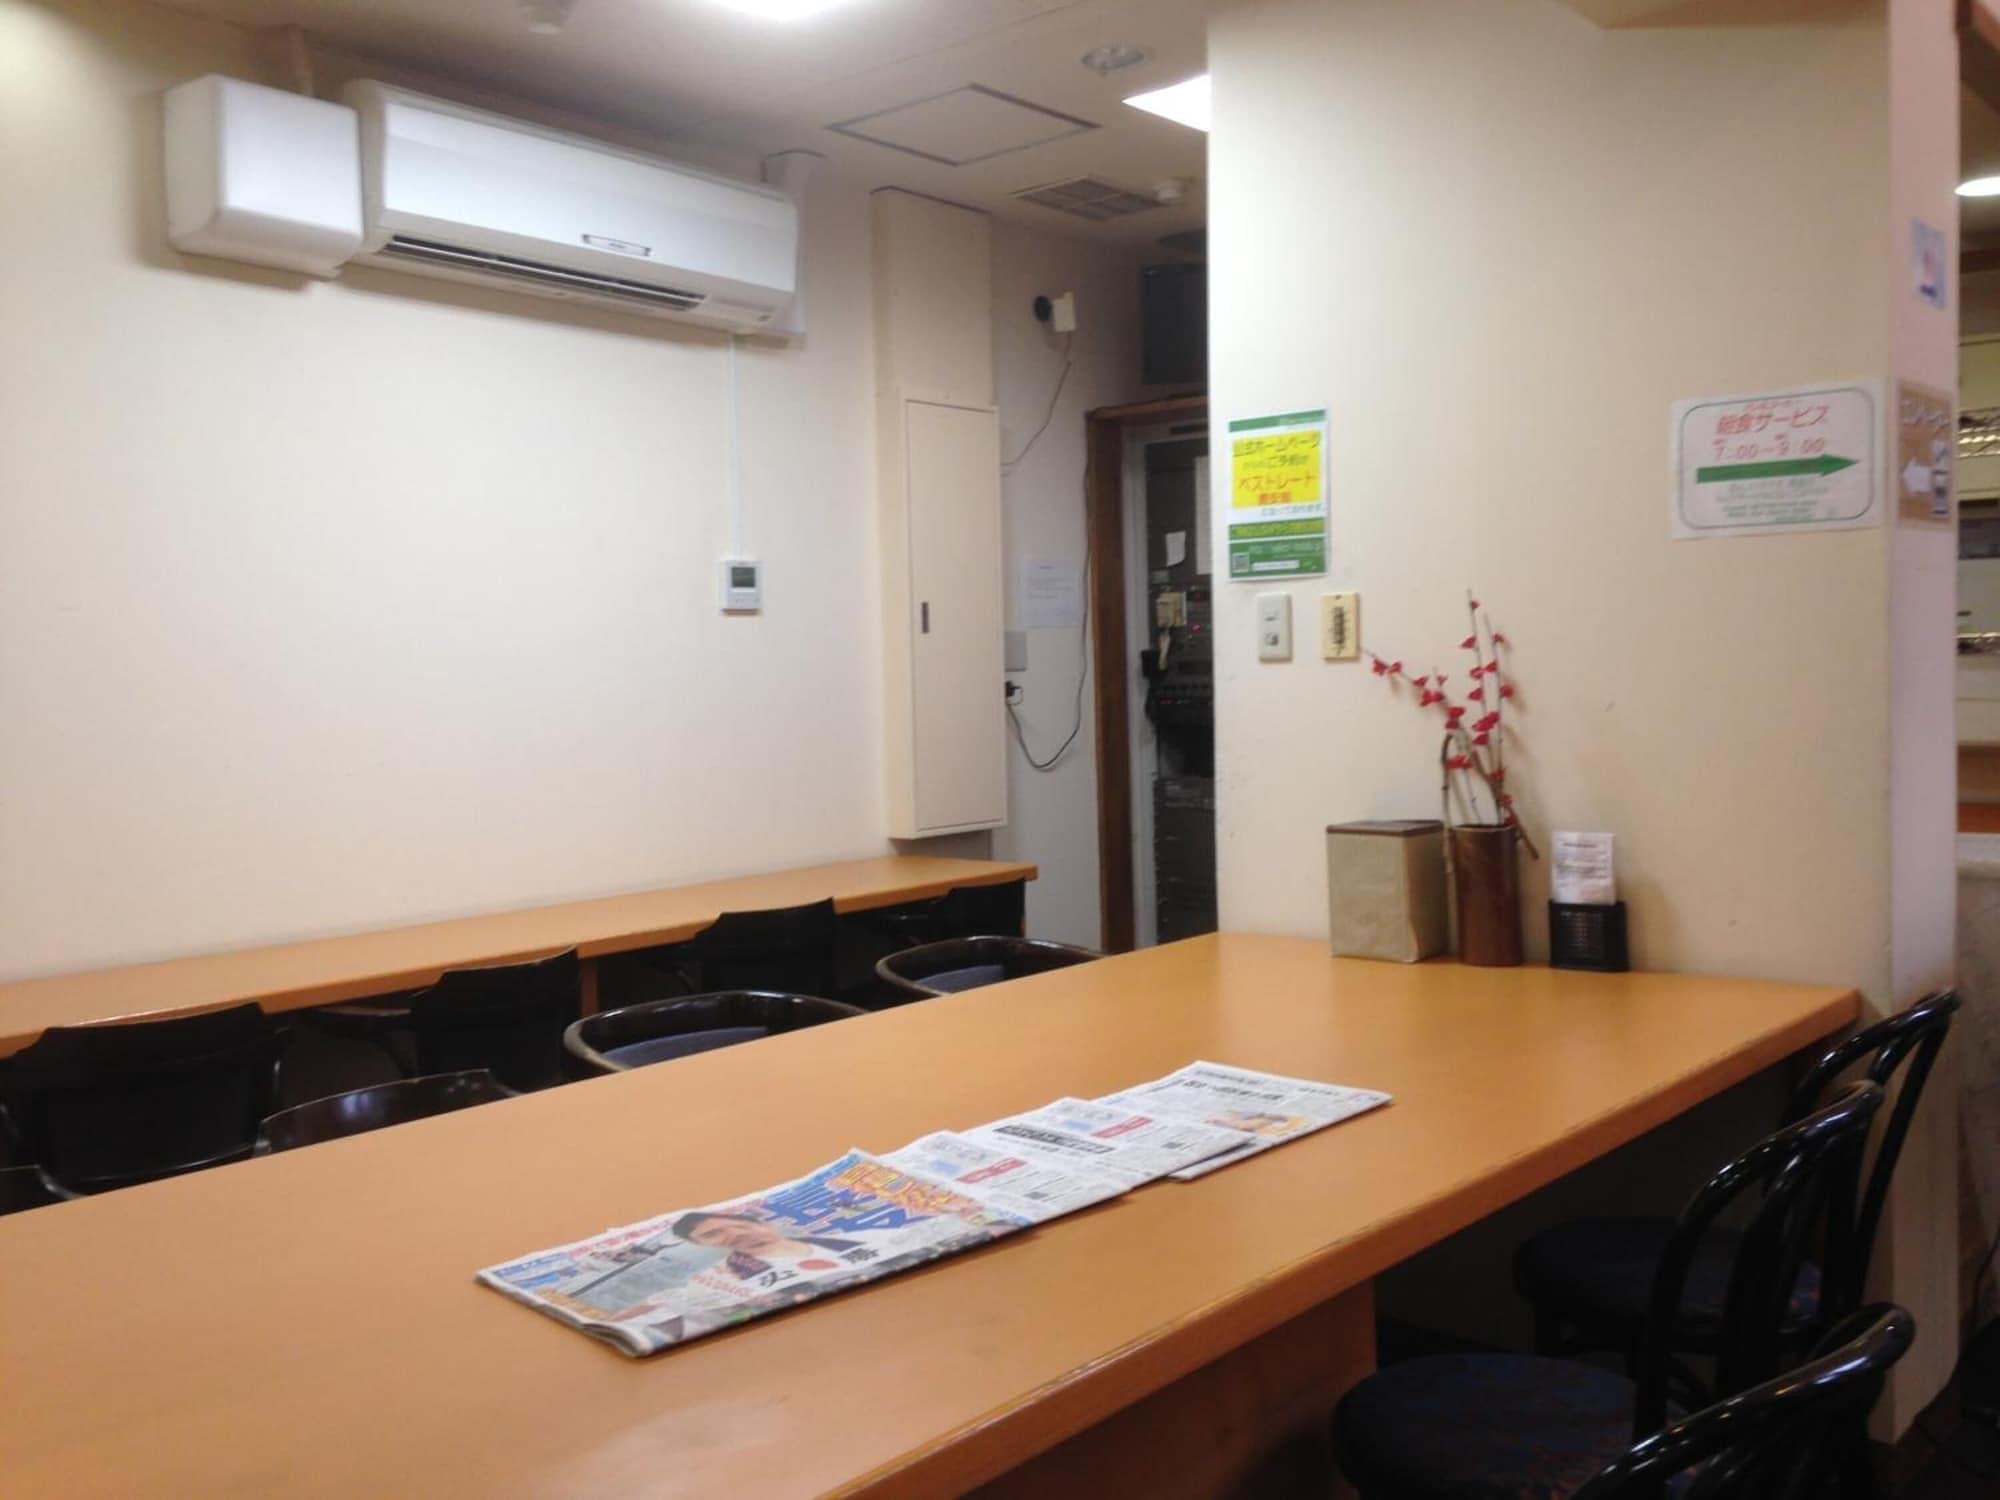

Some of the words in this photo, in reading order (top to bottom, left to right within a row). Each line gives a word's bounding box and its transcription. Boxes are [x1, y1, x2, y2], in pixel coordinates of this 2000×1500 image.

[1238, 470, 1317, 492] ベストレート
